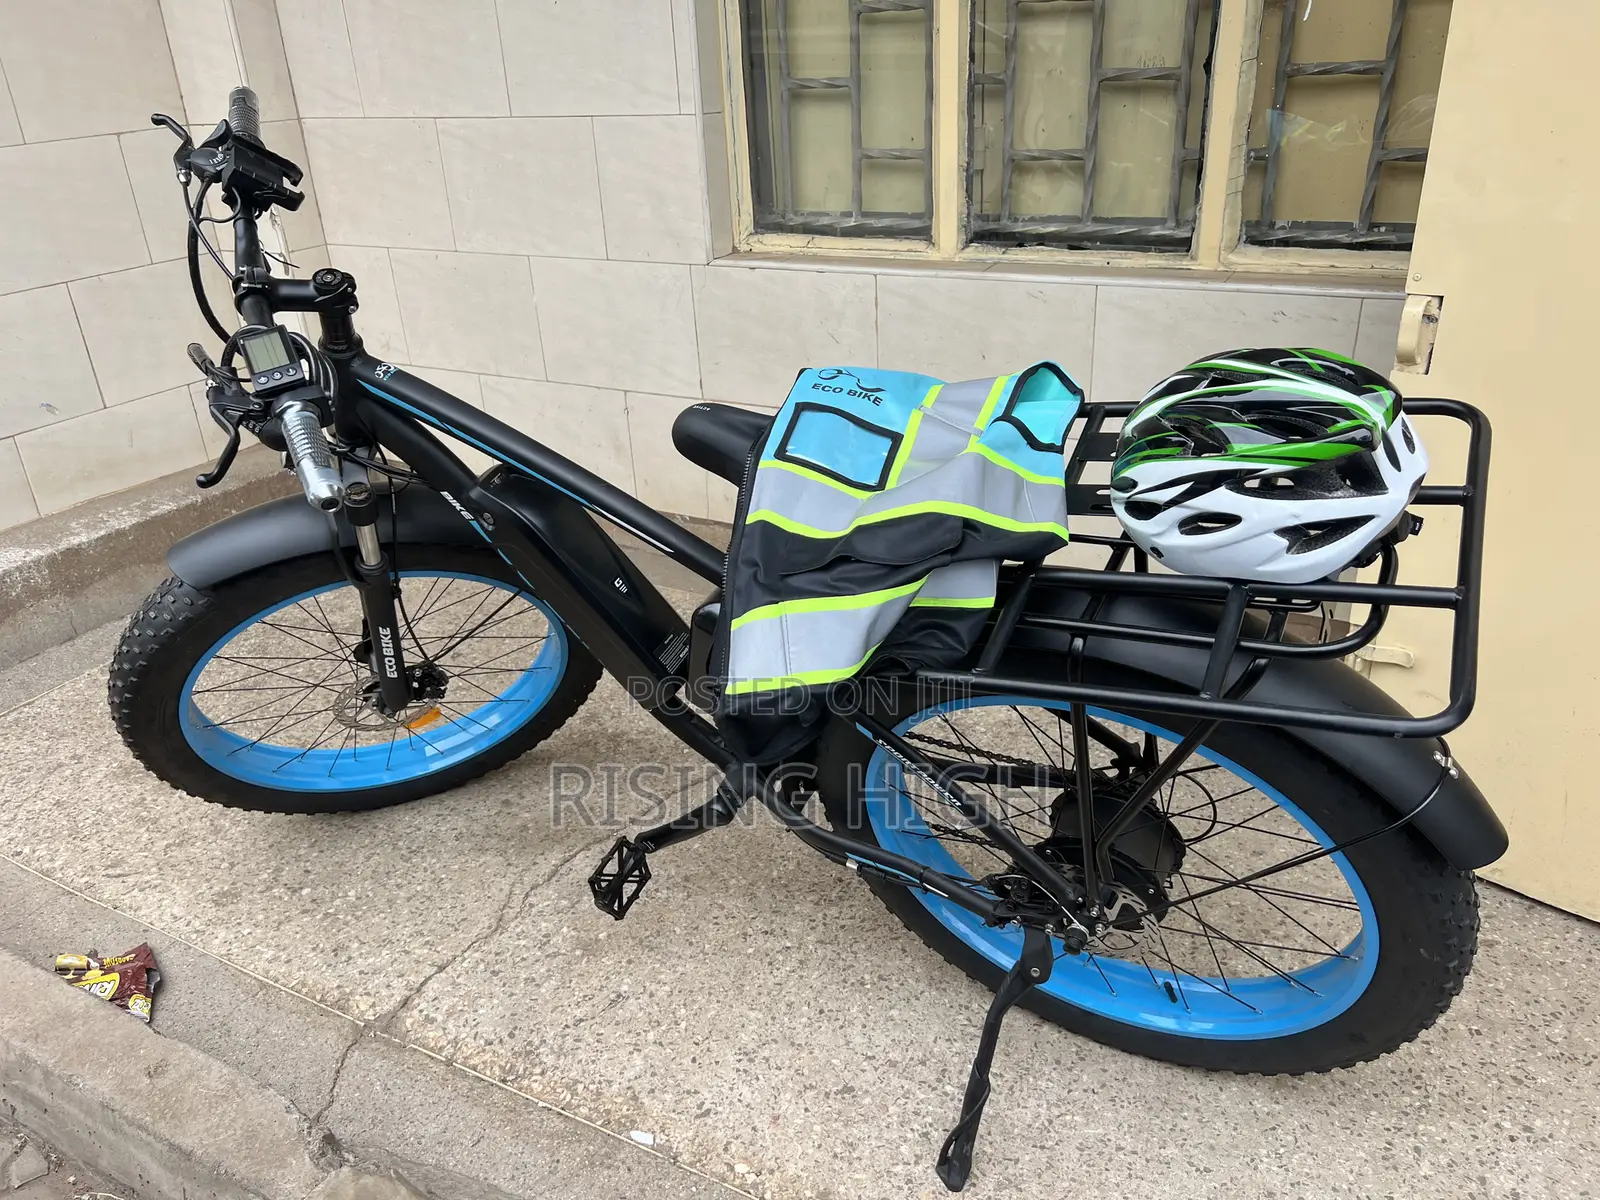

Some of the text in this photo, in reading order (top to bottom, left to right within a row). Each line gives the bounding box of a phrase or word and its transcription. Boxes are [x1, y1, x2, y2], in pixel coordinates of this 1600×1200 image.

[811, 382, 884, 407] ECO BIKE
[439, 491, 475, 521] BIKE
[378, 626, 398, 679] ECO BIKE
